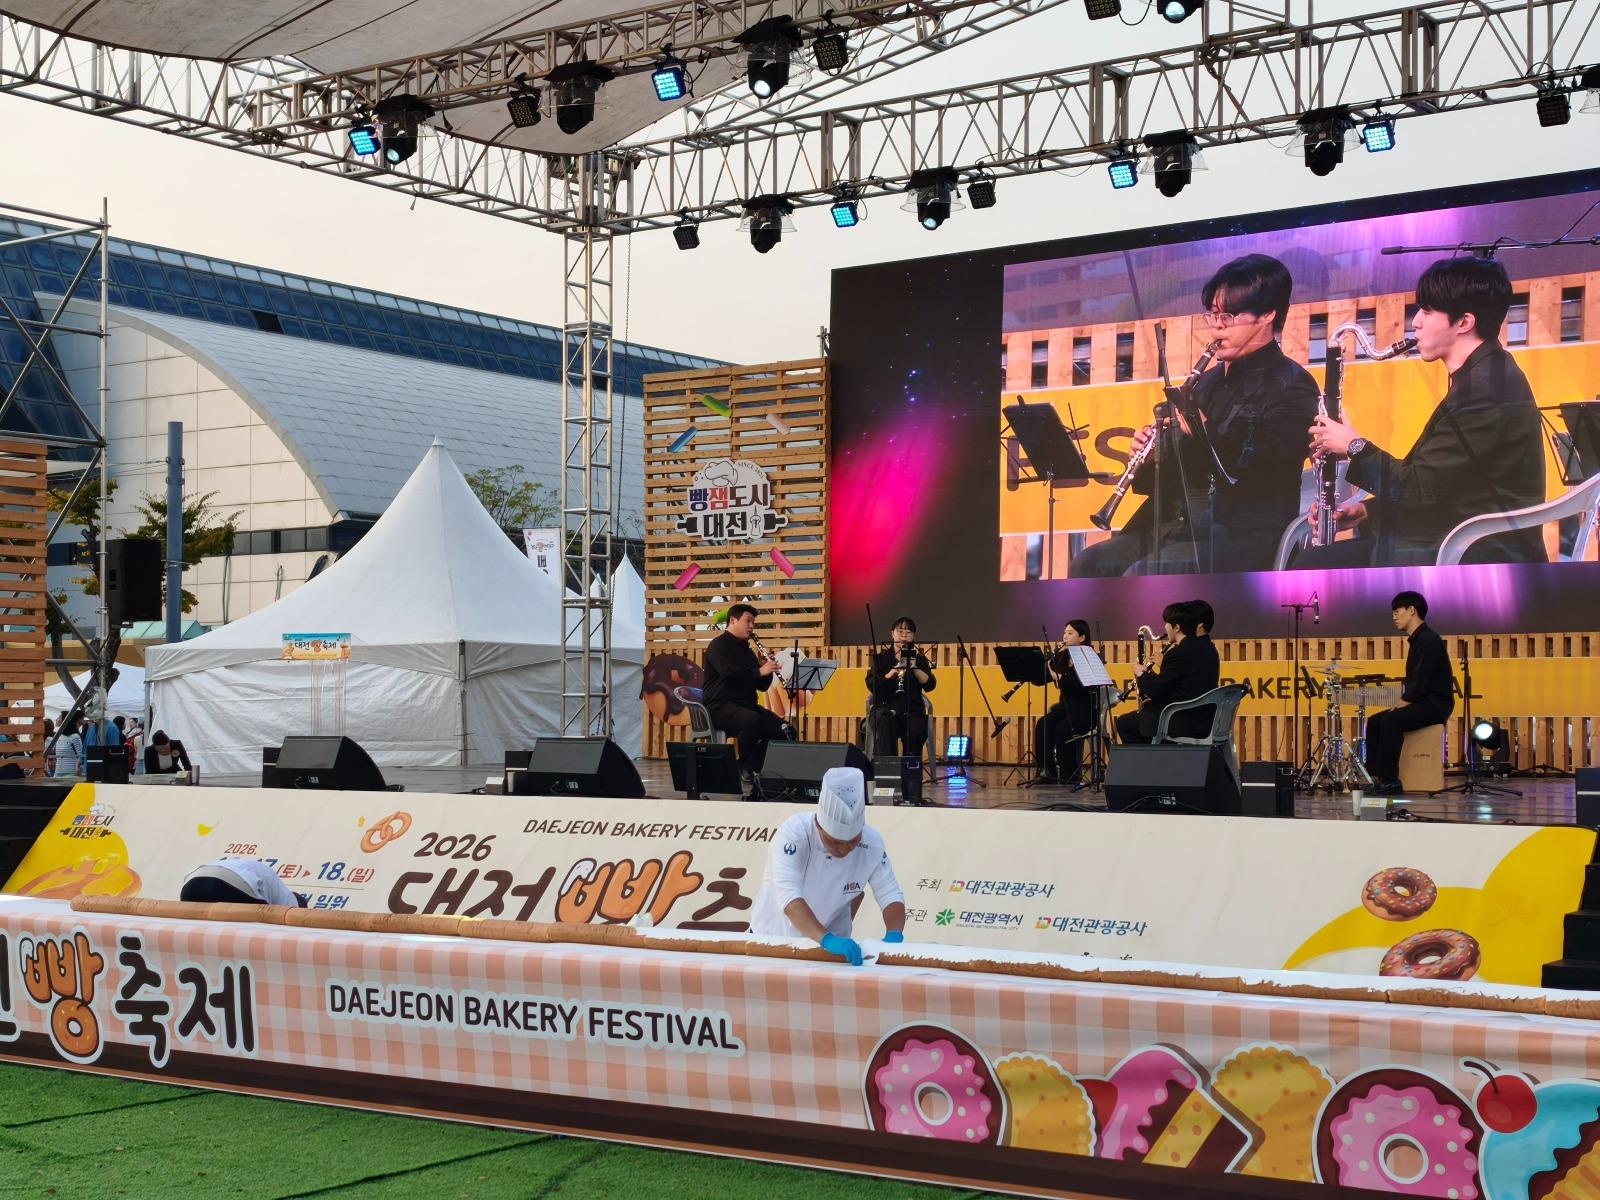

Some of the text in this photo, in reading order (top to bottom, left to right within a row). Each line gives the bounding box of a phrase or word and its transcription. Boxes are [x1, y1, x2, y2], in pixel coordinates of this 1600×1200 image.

[689, 484, 770, 511] 빵잼도시
[703, 512, 747, 538] 대전
[523, 819, 609, 836] DAEJEON
[611, 822, 687, 838] BAKERY
[414, 833, 497, 862] 2026
[916, 878, 942, 892] 주최
[965, 880, 1055, 898] 대전관광공사
[905, 908, 928, 922] 주관
[959, 911, 1024, 926] 대전광역시
[1053, 917, 1148, 937] 대전관광공사
[0, 931, 255, 1062] 빵축제
[330, 984, 739, 1050] DAEJEON BAKERY FESTIVAL
